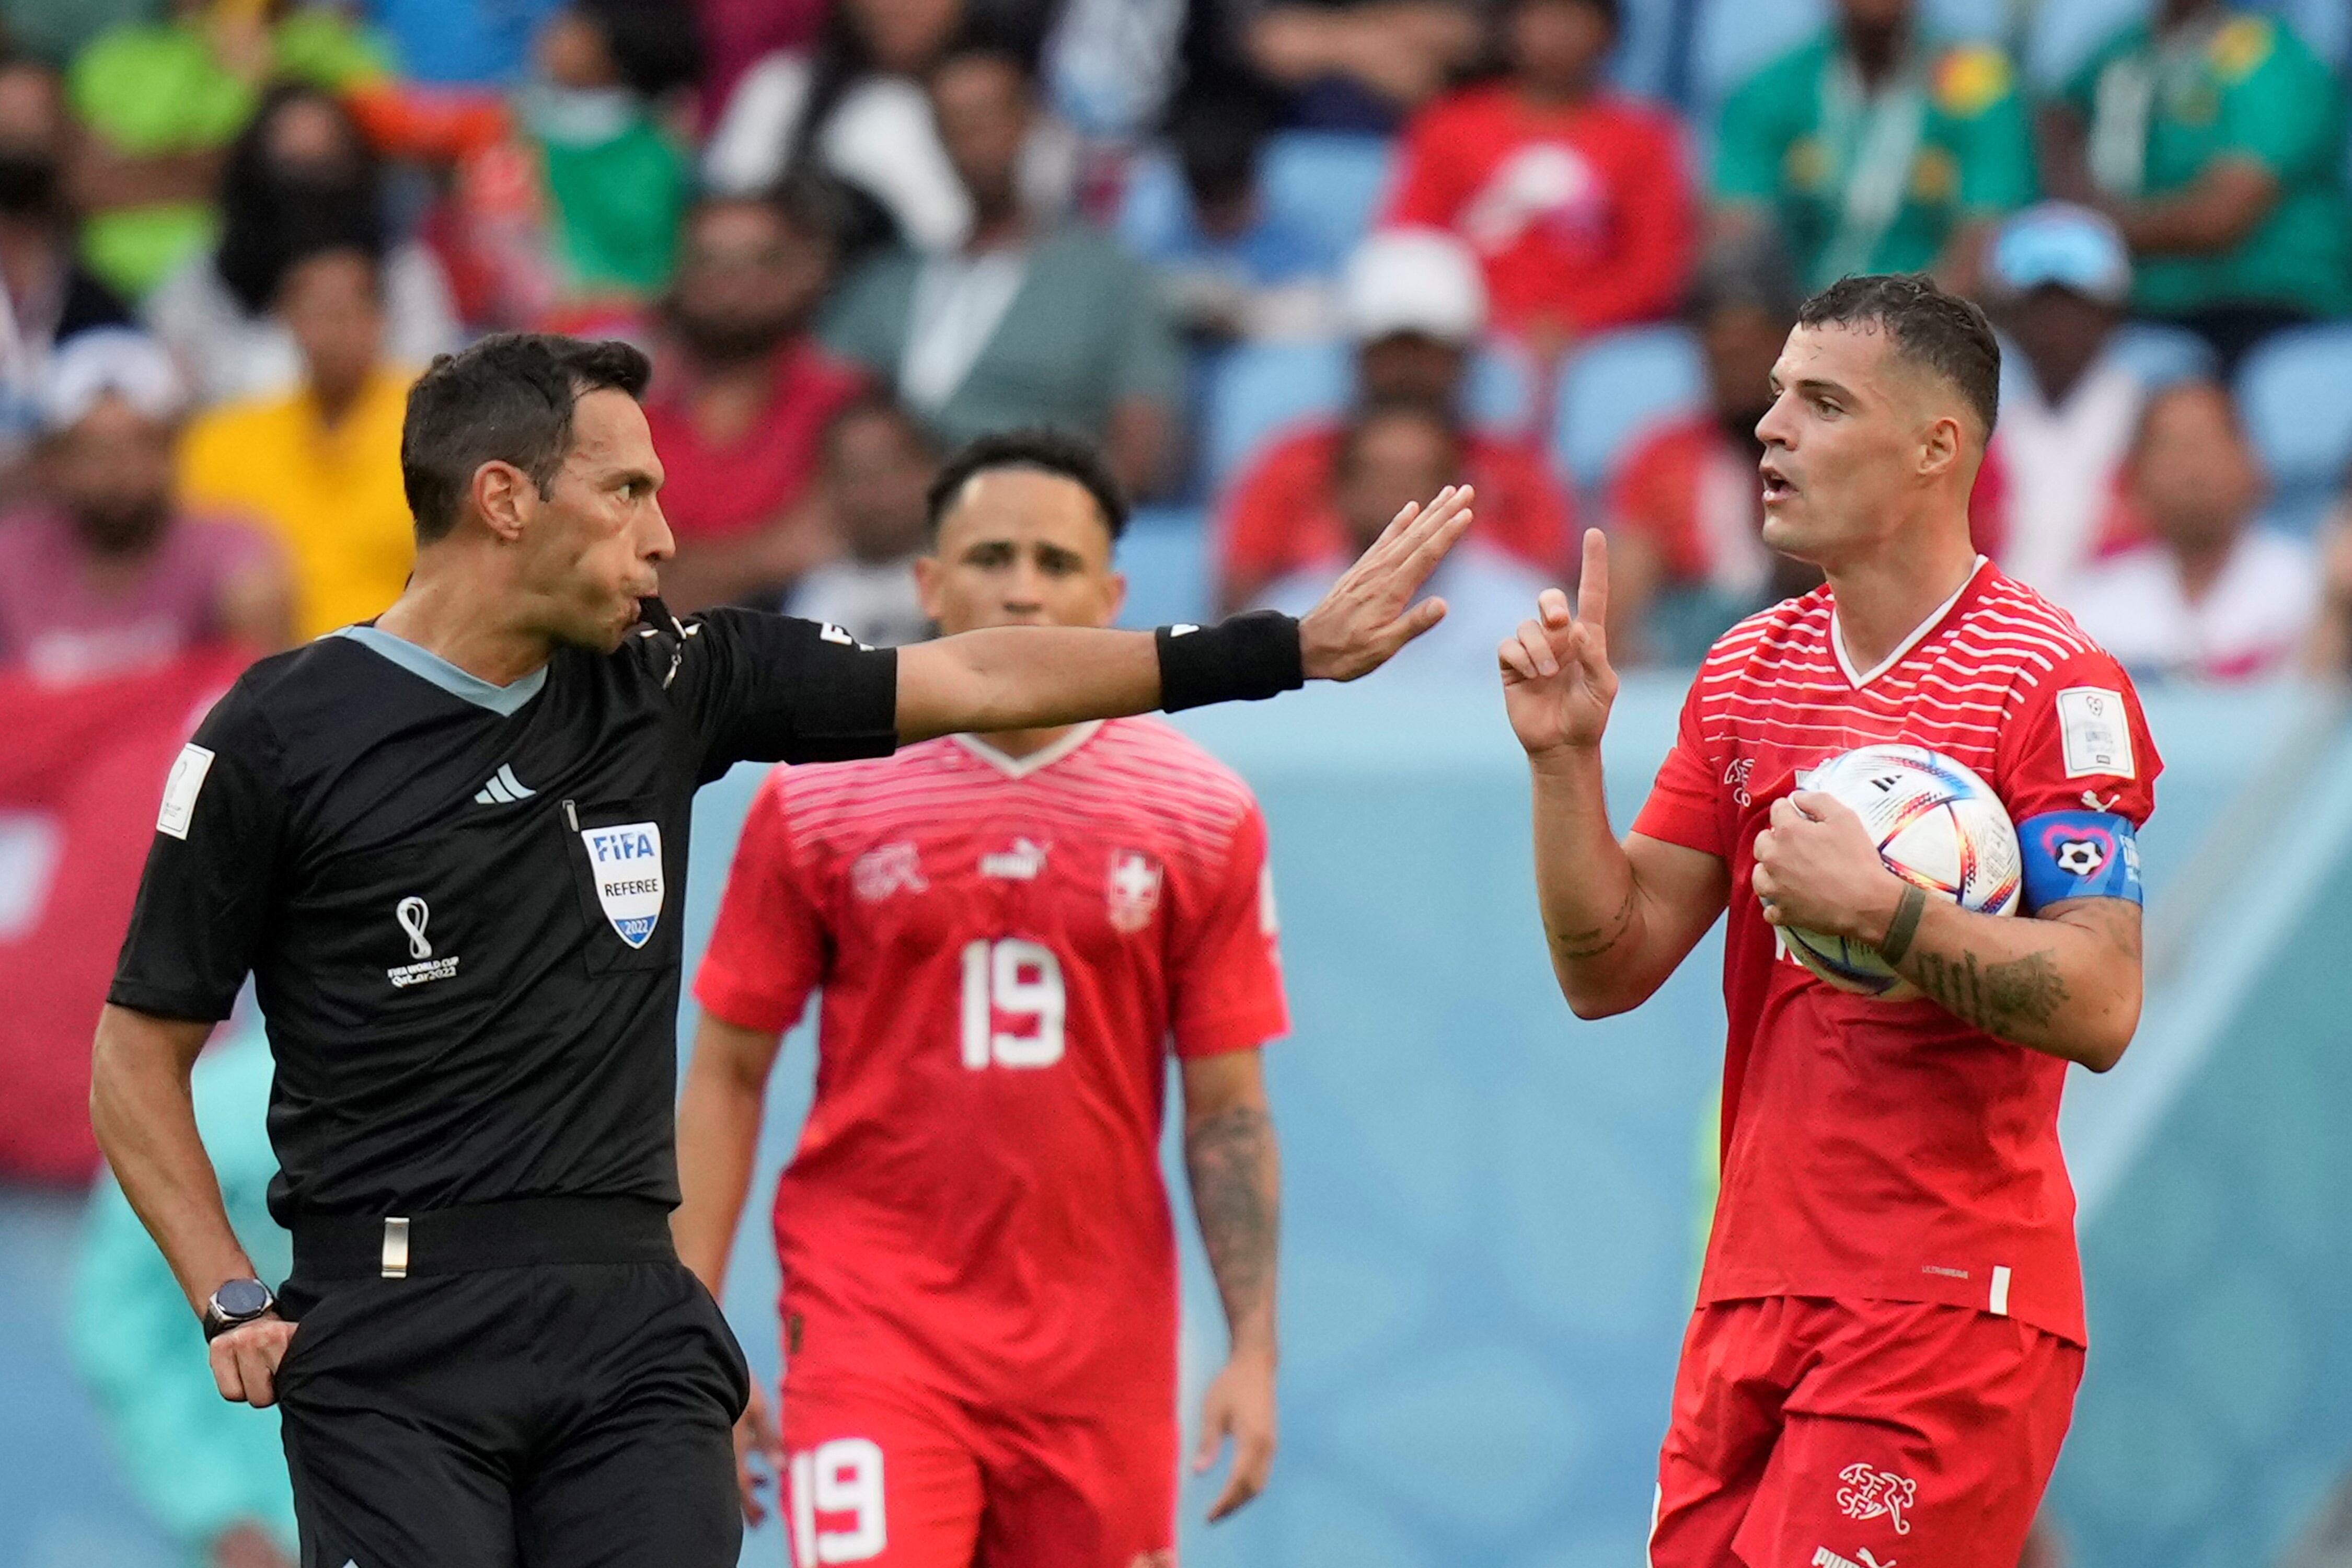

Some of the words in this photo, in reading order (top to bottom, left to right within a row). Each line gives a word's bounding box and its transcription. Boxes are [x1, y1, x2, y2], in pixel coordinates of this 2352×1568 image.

[593, 832, 655, 862] FIFA
[604, 878, 659, 897] REFEREE
[625, 919, 649, 935] 2022
[407, 960, 441, 974] WORLD
[441, 956, 459, 967] CUP
[961, 938, 1065, 1070] 19
[791, 1437, 887, 1568] 19
